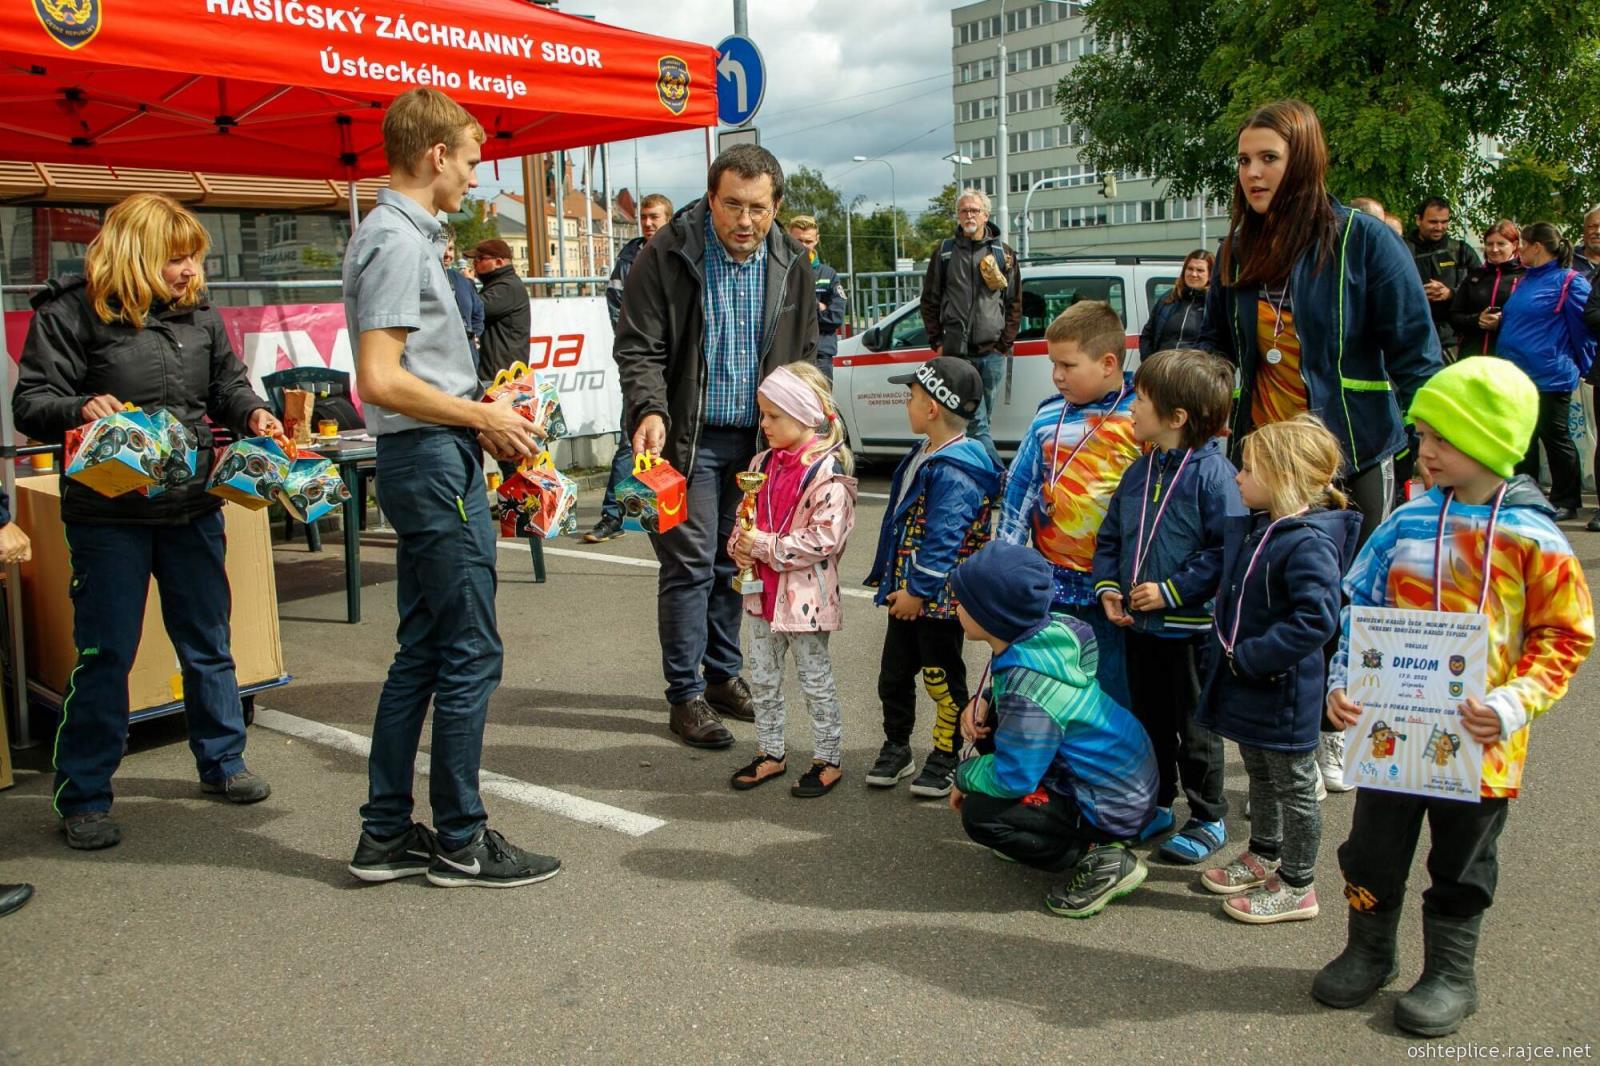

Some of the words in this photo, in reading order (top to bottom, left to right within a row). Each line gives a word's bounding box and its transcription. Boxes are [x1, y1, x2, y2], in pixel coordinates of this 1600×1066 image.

[206, 0, 367, 34] HASIČSKÝ
[375, 13, 534, 59] ZÁCHRANNÝ
[540, 41, 602, 68] SBOR
[319, 46, 461, 88] Ústeckého
[468, 69, 528, 99] kraje
[915, 363, 961, 410] didas
[1392, 656, 1439, 671] DIPLOM
